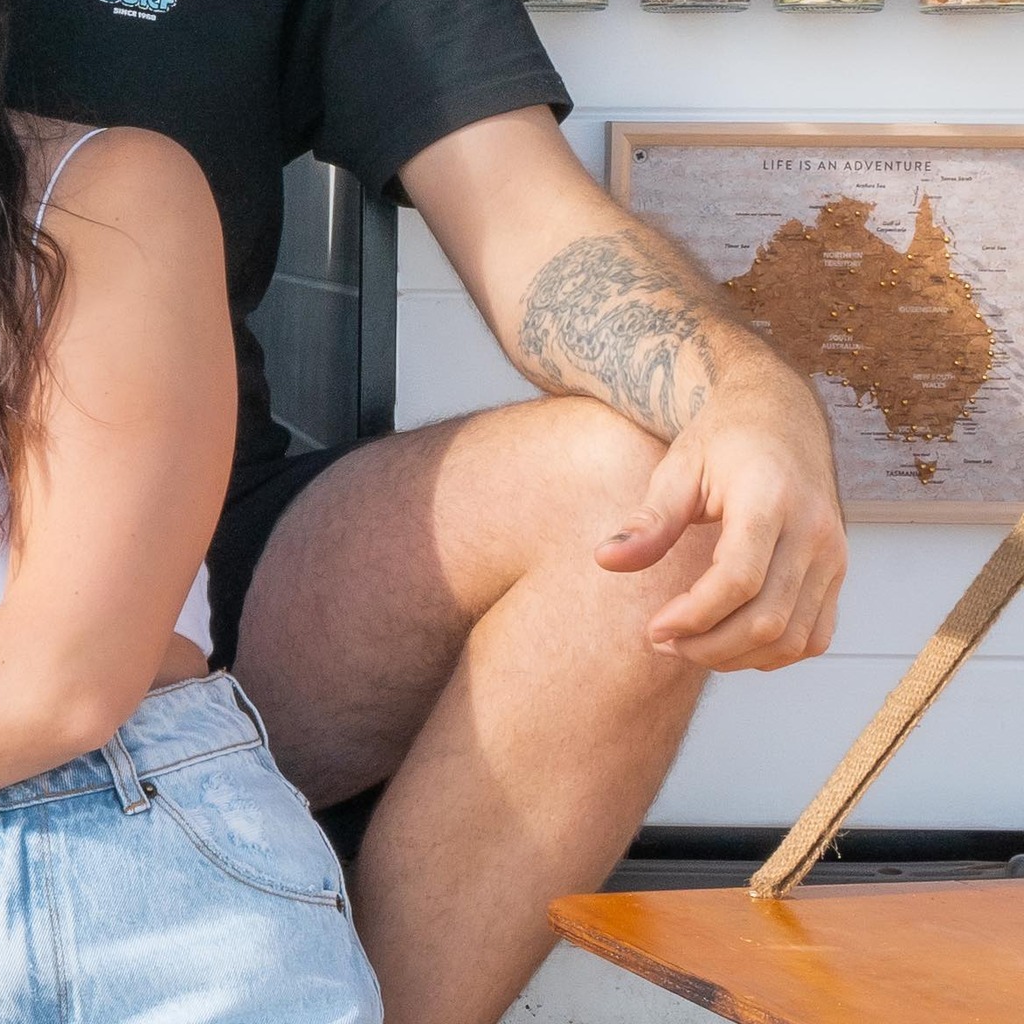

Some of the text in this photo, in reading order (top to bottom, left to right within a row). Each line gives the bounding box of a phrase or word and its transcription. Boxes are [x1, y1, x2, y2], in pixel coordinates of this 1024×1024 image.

[113, 7, 137, 17] SINCE
[763, 160, 932, 172] LIFE IS AN ADVENTURE
